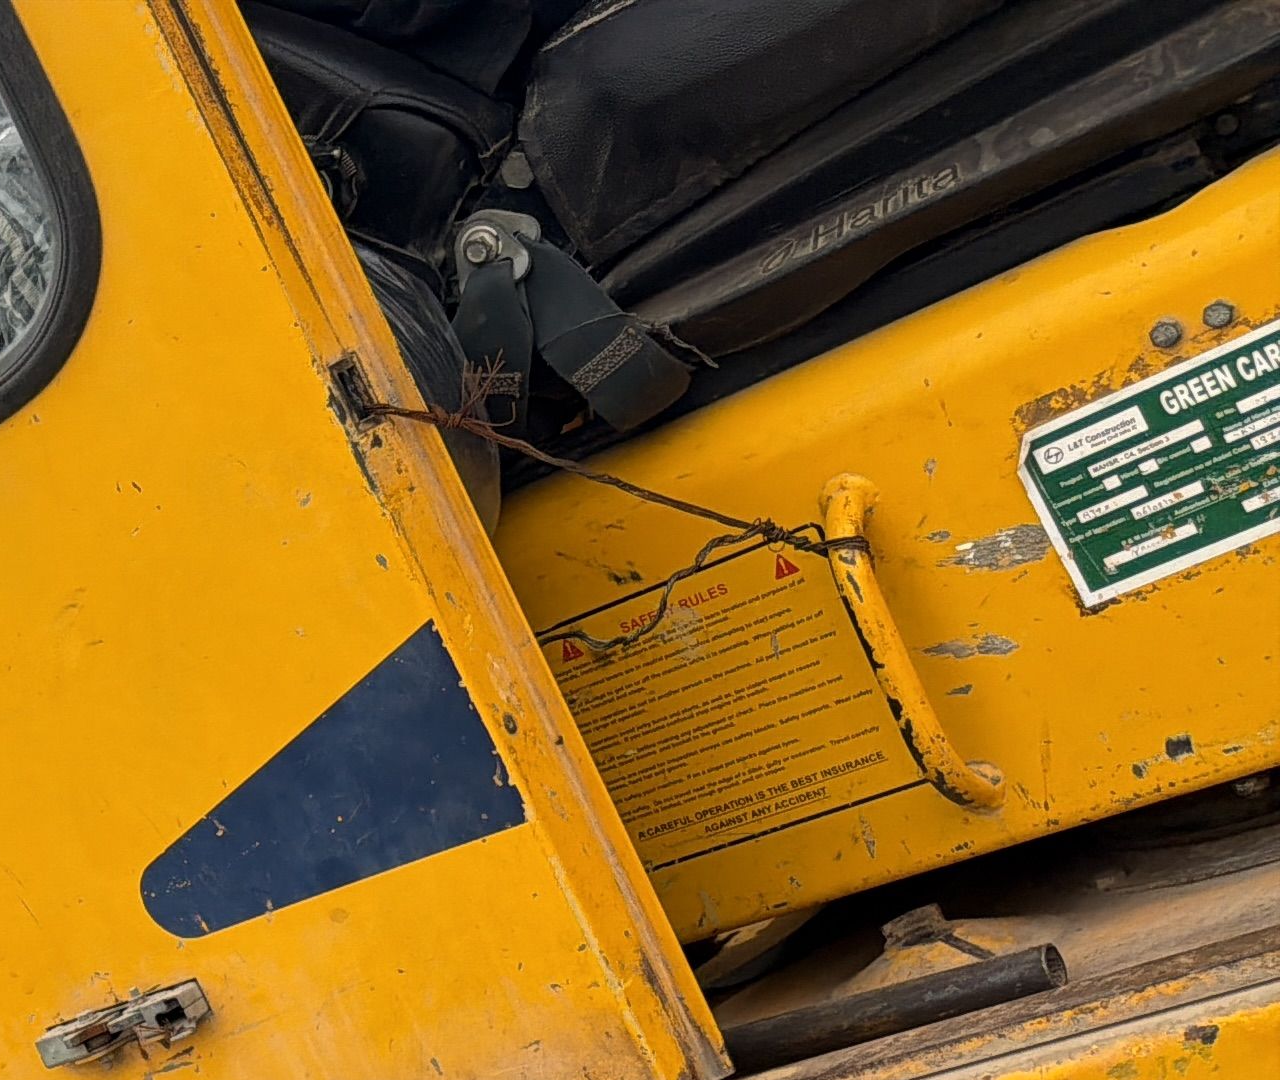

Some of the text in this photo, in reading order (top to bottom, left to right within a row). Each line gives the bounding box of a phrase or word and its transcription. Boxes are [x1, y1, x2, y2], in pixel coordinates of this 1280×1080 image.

[808, 162, 962, 252] Harita
[1160, 342, 1280, 415] GREEN CAR
[1066, 415, 1136, 452] L&T Construction
[619, 603, 675, 634] SAFEY
[679, 583, 728, 610] RULES
[636, 830, 646, 839] A
[645, 814, 694, 836] CAREFUL
[693, 794, 754, 820] OPERATION
[753, 790, 766, 800] IS
[766, 782, 789, 796] THE
[789, 772, 819, 788] BEST
[819, 750, 884, 778] INSURANCE
[703, 786, 827, 833] AGAINST ANY ACCIDENT
